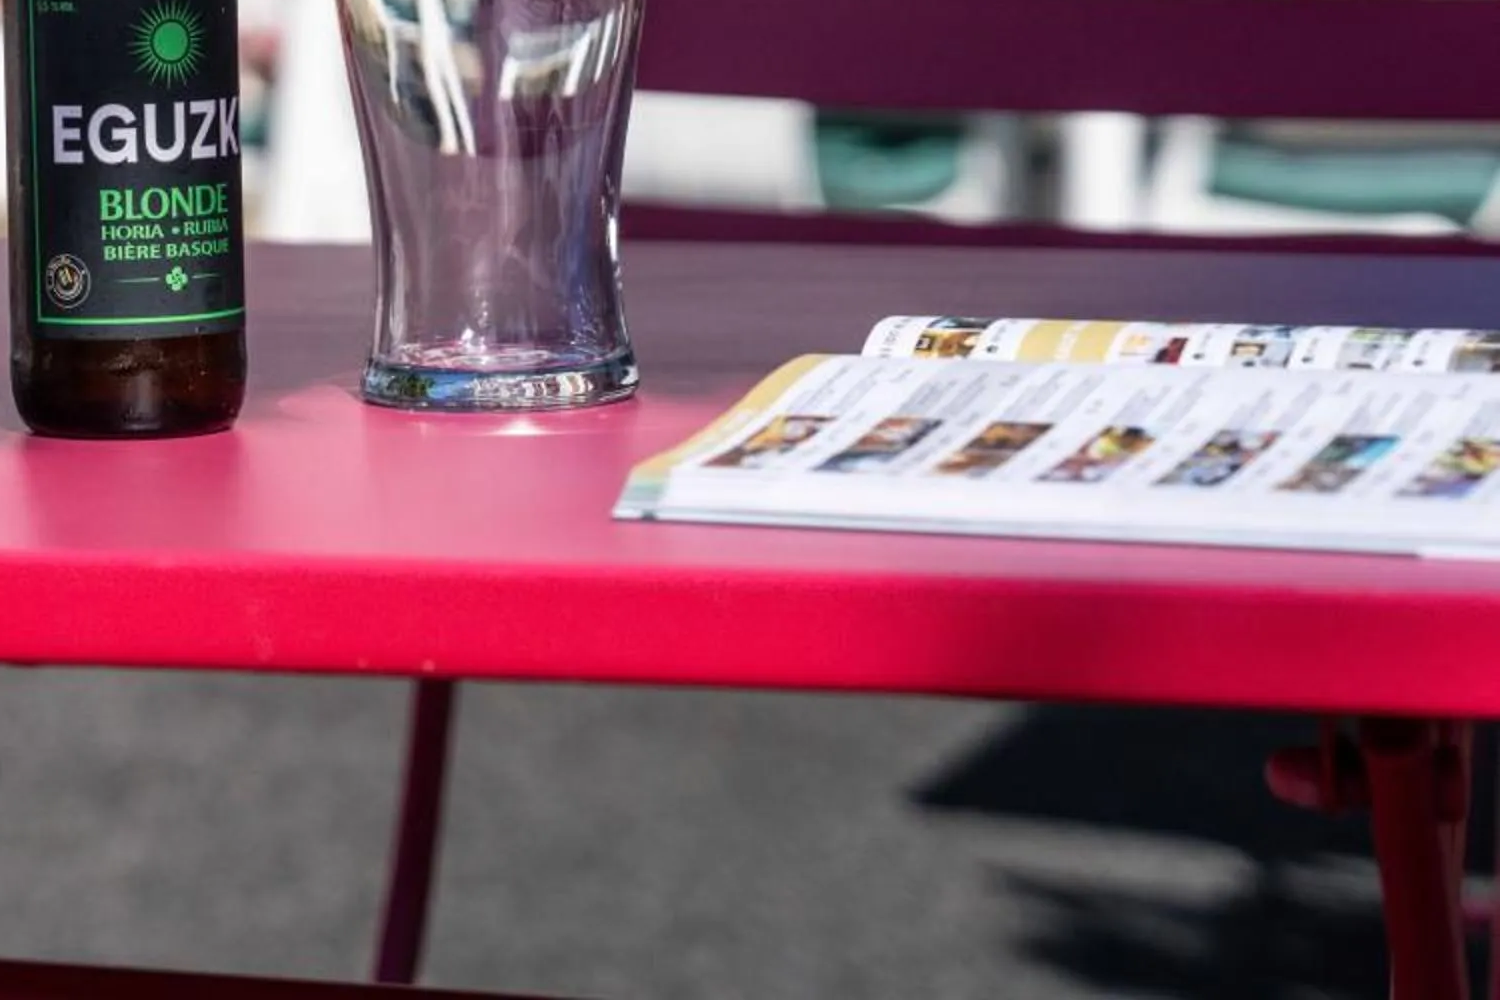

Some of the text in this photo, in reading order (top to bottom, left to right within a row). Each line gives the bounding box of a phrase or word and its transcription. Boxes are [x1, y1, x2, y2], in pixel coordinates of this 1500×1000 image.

[99, 182, 228, 220] BLONDE
[101, 218, 228, 240] HORIA RUBIA
[103, 238, 228, 260] BIÈRE BASQUE
